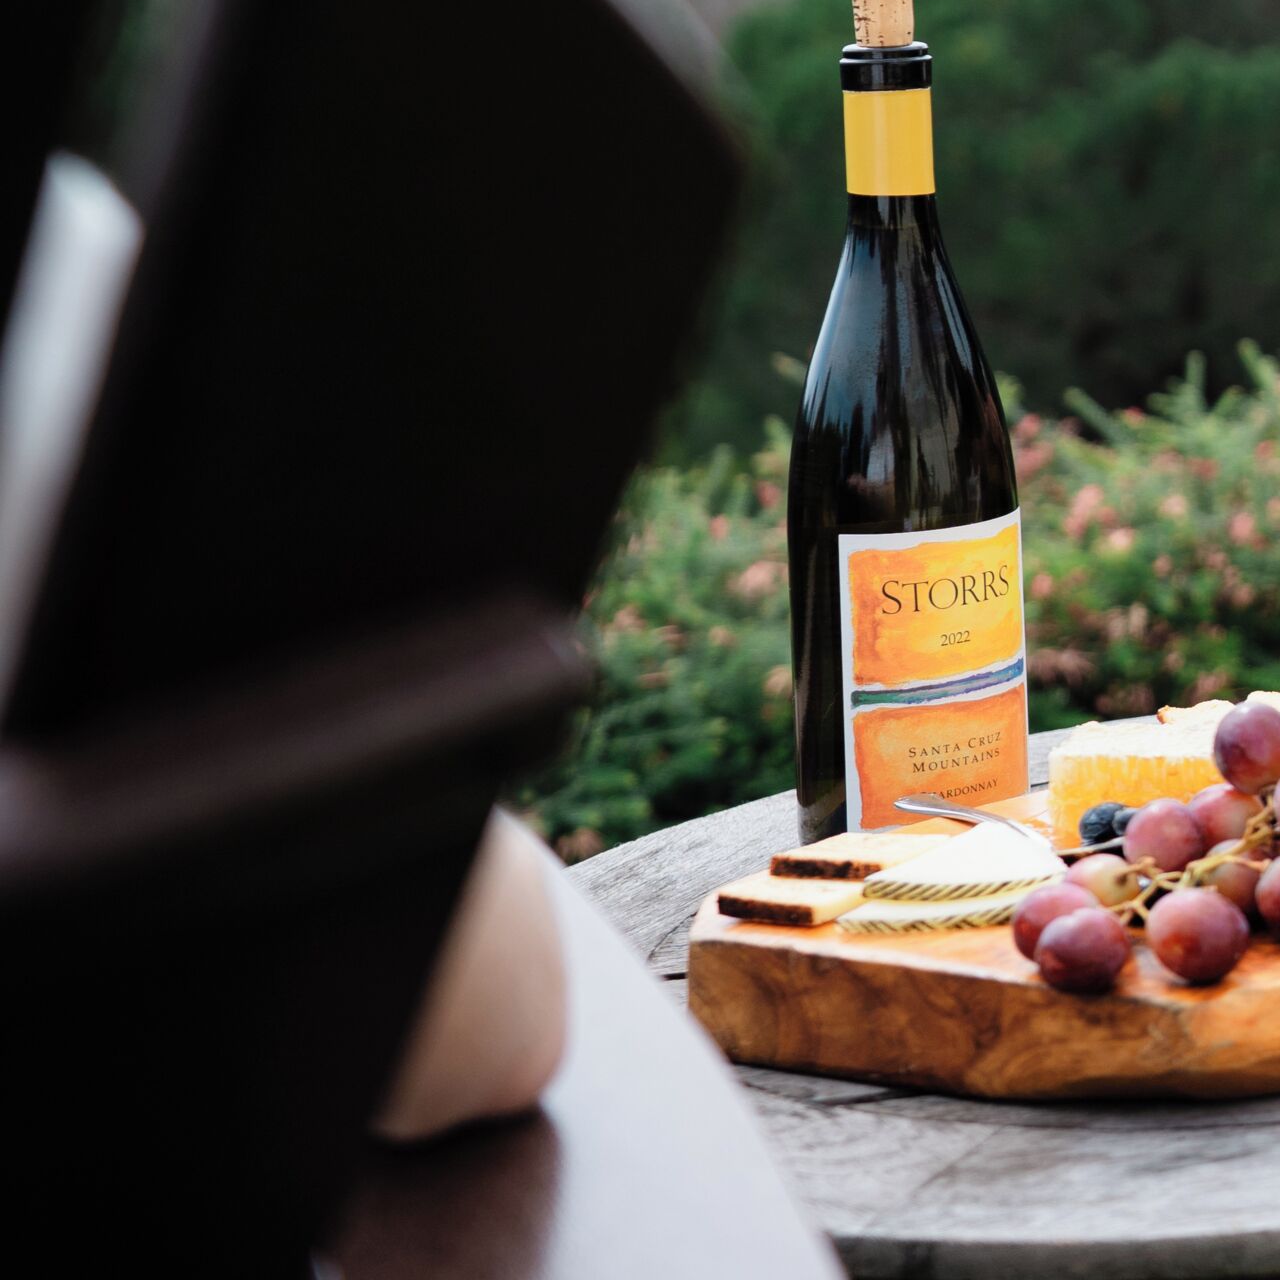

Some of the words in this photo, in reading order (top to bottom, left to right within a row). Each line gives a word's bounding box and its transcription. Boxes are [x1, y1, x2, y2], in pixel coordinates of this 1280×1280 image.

[881, 564, 1010, 615] STORRS
[940, 630, 972, 647] 2022
[908, 743, 961, 759] SANTA
[967, 731, 1001, 749] CRUZ
[912, 747, 1001, 774] MOUNTAINS
[921, 778, 998, 799] ARDONNAY
